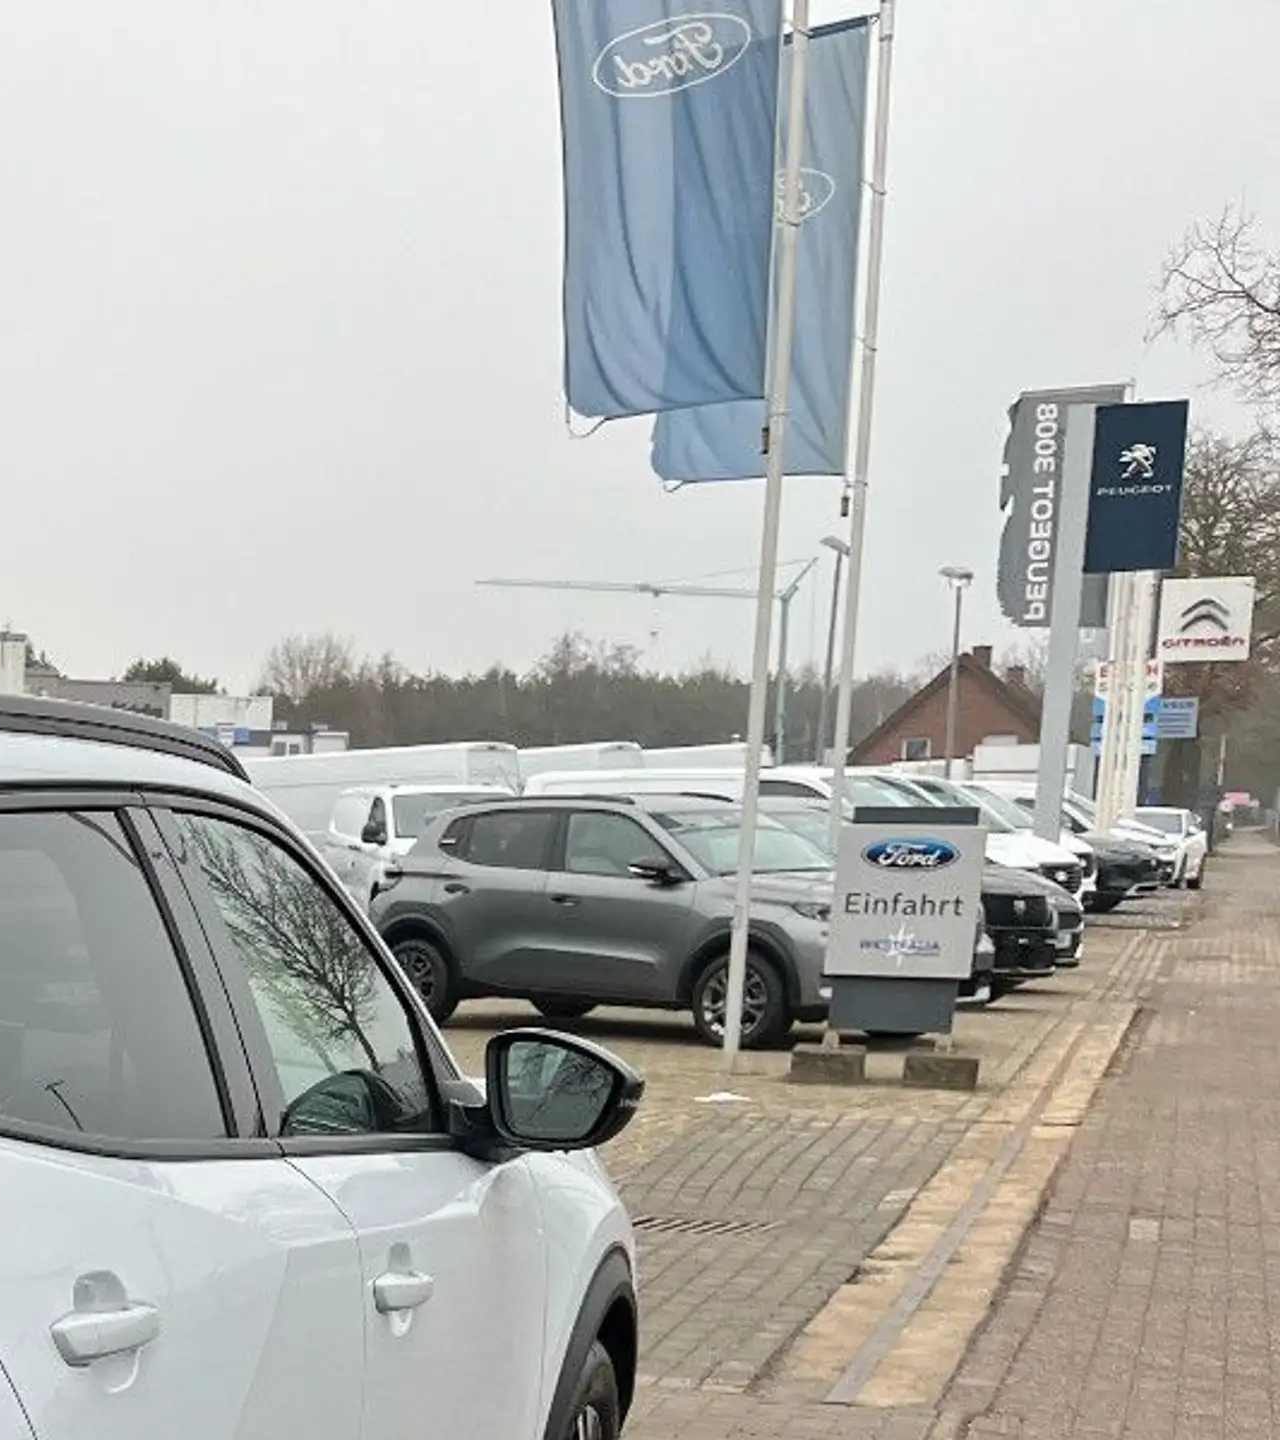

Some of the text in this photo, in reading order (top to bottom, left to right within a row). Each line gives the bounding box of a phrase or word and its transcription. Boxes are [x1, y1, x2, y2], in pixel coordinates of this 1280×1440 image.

[1096, 484, 1172, 496] PEUGEOT
[877, 843, 942, 867] Ford
[844, 892, 964, 917] Einfahrt
